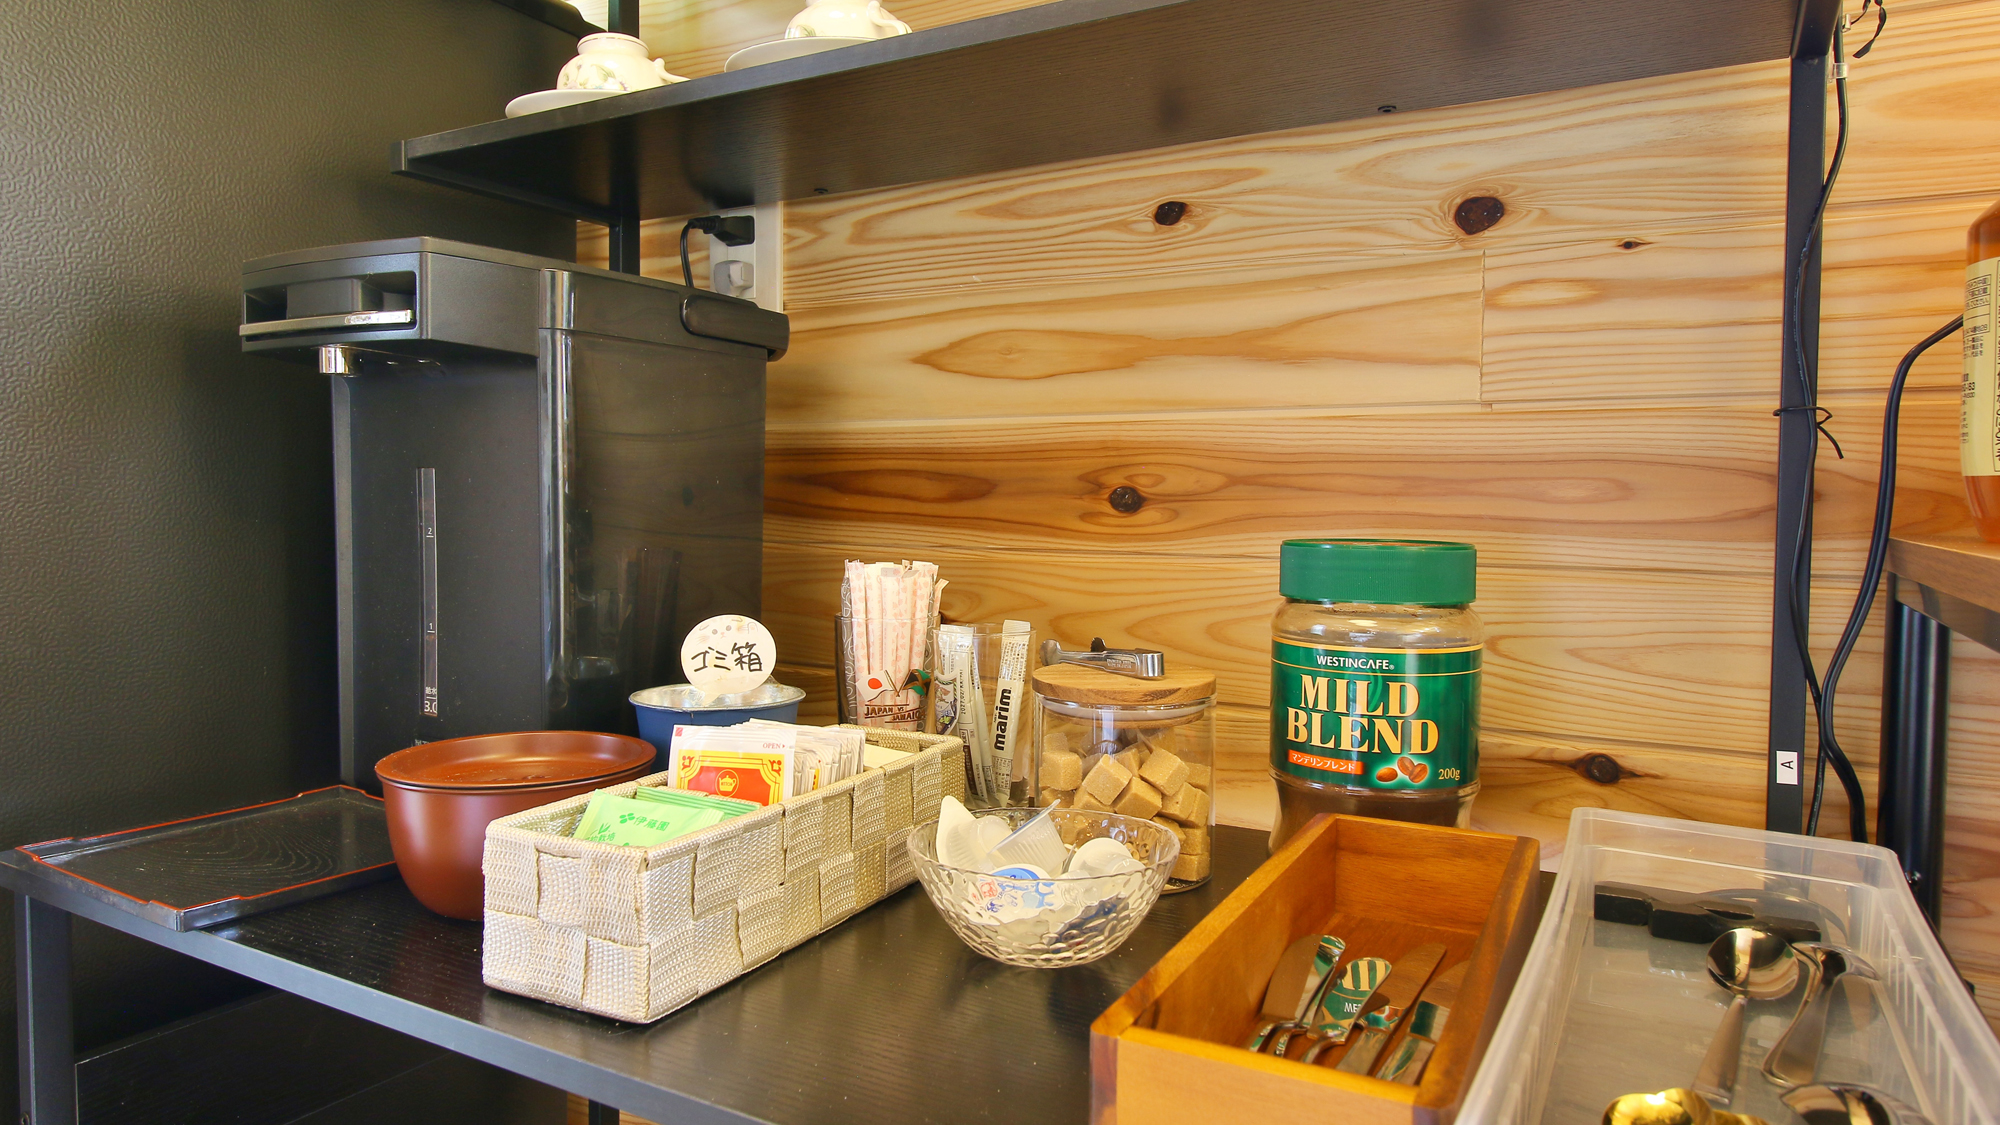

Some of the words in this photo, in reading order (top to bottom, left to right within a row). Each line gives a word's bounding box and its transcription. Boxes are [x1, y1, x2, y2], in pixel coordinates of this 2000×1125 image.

[427, 527, 433, 535] 2
[691, 641, 763, 673] ゴミ箱
[1316, 654, 1389, 670] WESTINCAFE
[1300, 673, 1420, 718] MILD
[864, 706, 894, 717] JAPAN
[994, 687, 1012, 751] marim
[1286, 706, 1440, 756] BLEND
[1291, 752, 1356, 772] マンデリンブレンド
[1780, 760, 1794, 770] A
[1438, 767, 1461, 781] 200g
